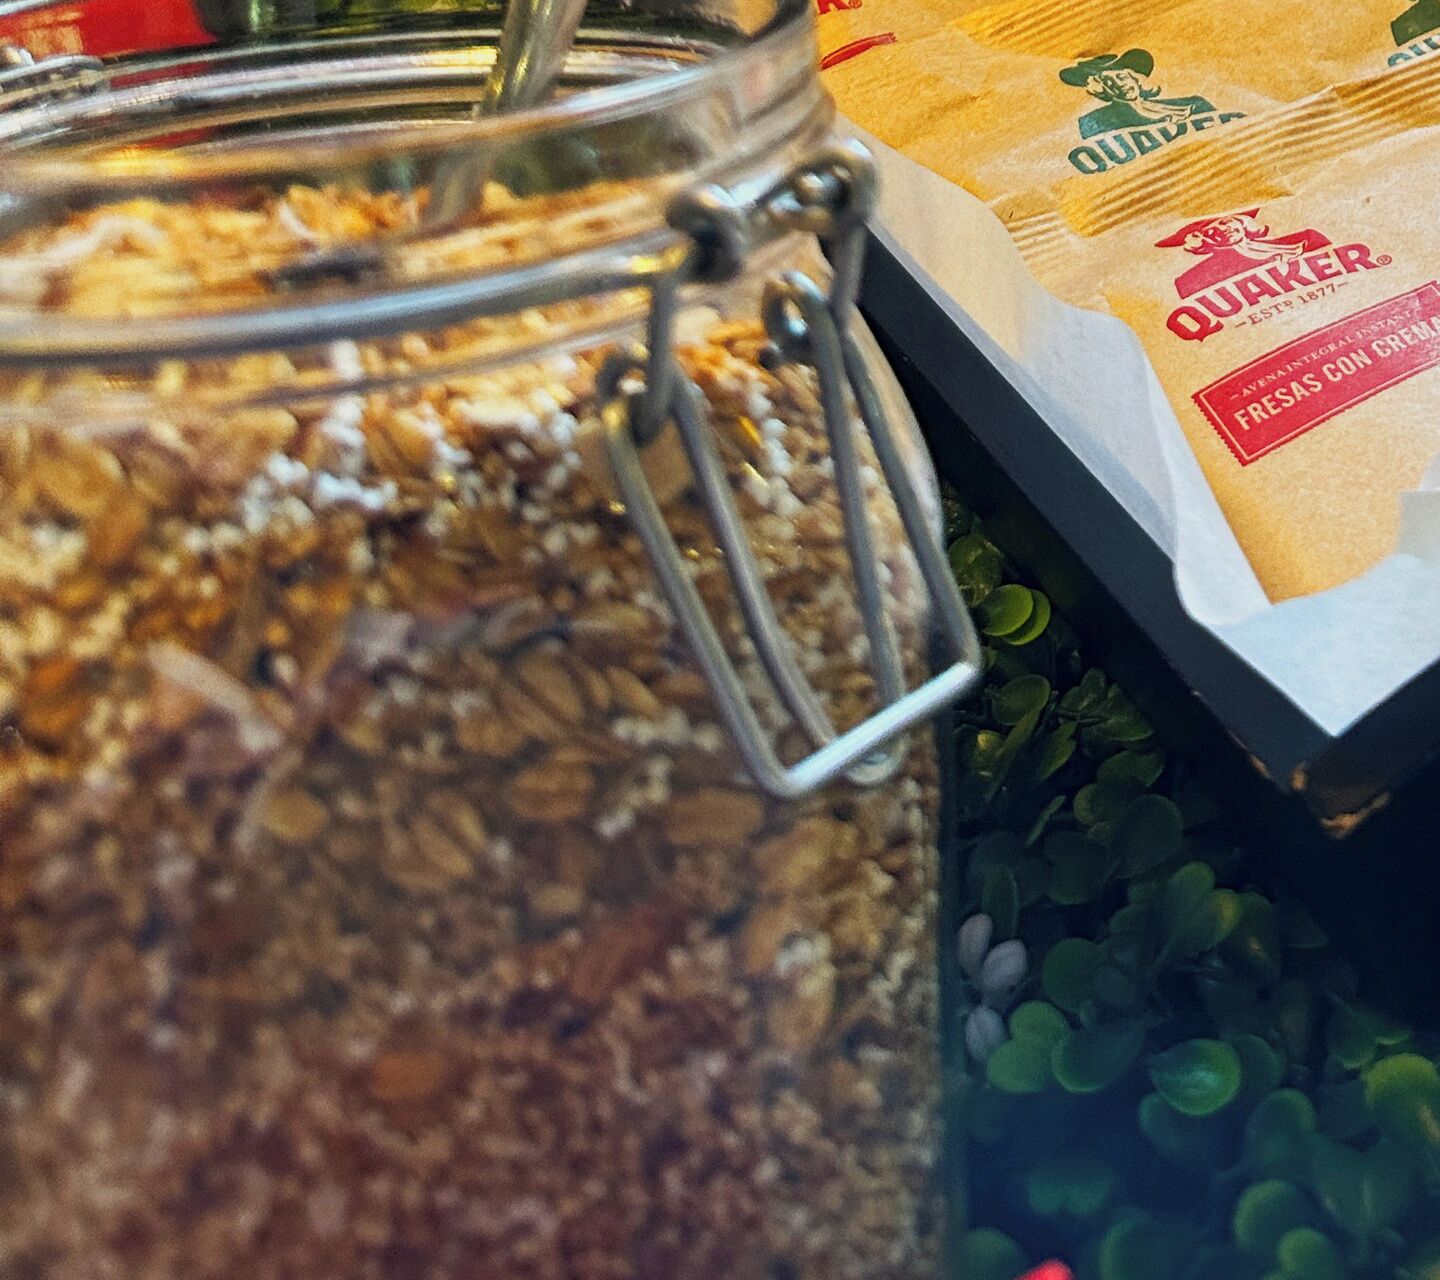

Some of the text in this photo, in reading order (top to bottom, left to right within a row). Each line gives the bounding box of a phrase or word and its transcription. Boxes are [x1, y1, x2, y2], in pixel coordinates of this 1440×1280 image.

[1165, 243, 1382, 343] QUAKER
[1301, 283, 1338, 305] 1877
[1233, 373, 1324, 431] FRESAS
[1321, 348, 1373, 383] CON
[1242, 369, 1288, 397] AVENA
[1286, 336, 1356, 373] INTEGRAL
